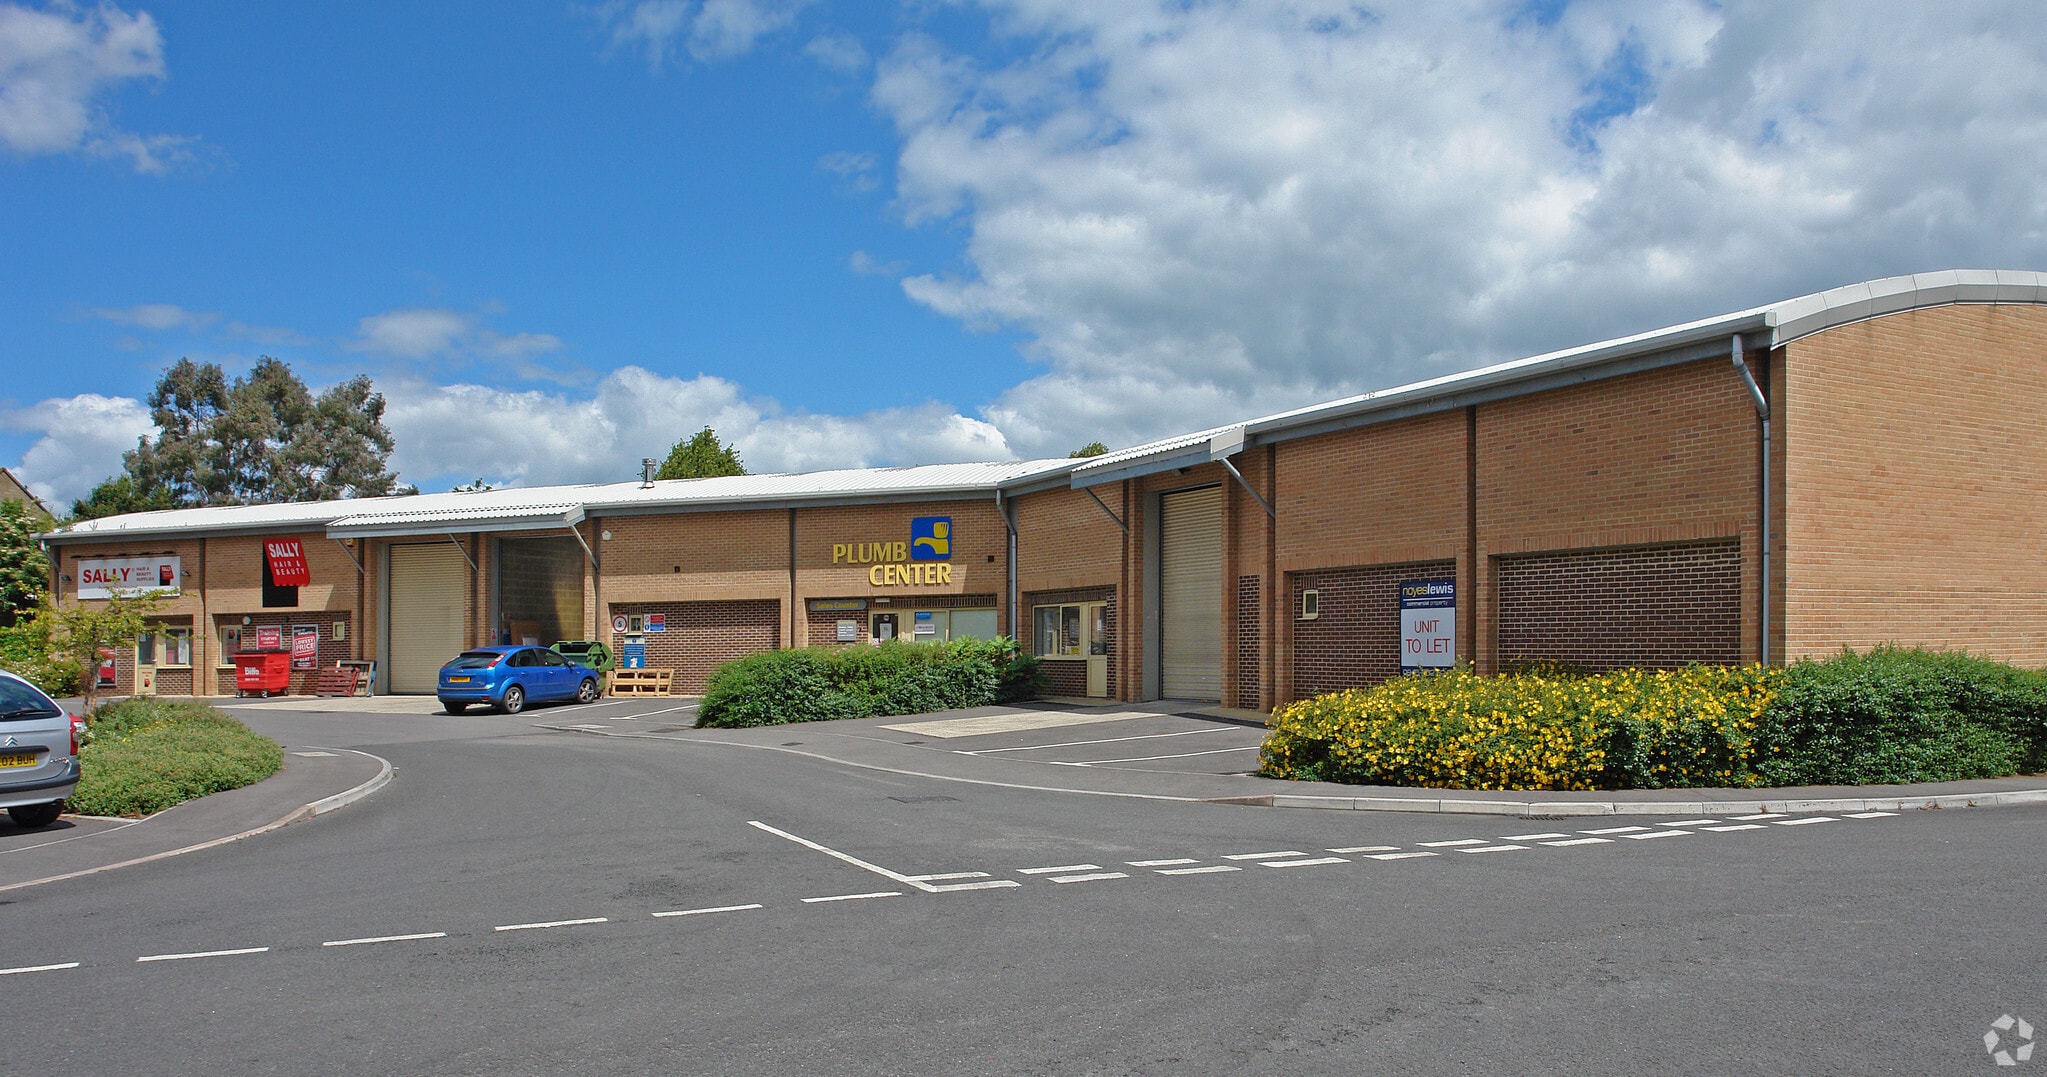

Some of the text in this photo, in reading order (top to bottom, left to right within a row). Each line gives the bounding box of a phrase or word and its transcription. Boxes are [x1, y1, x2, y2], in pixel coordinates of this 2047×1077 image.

[268, 543, 300, 558] SALLY
[833, 541, 907, 564] PLUMB
[83, 568, 131, 583] SALLY
[869, 562, 952, 586] CENTER
[1402, 582, 1454, 597] noyeslewis
[1414, 620, 1439, 634] UNIT
[1406, 638, 1451, 653] TO LET
[17, 754, 35, 764] BUH
